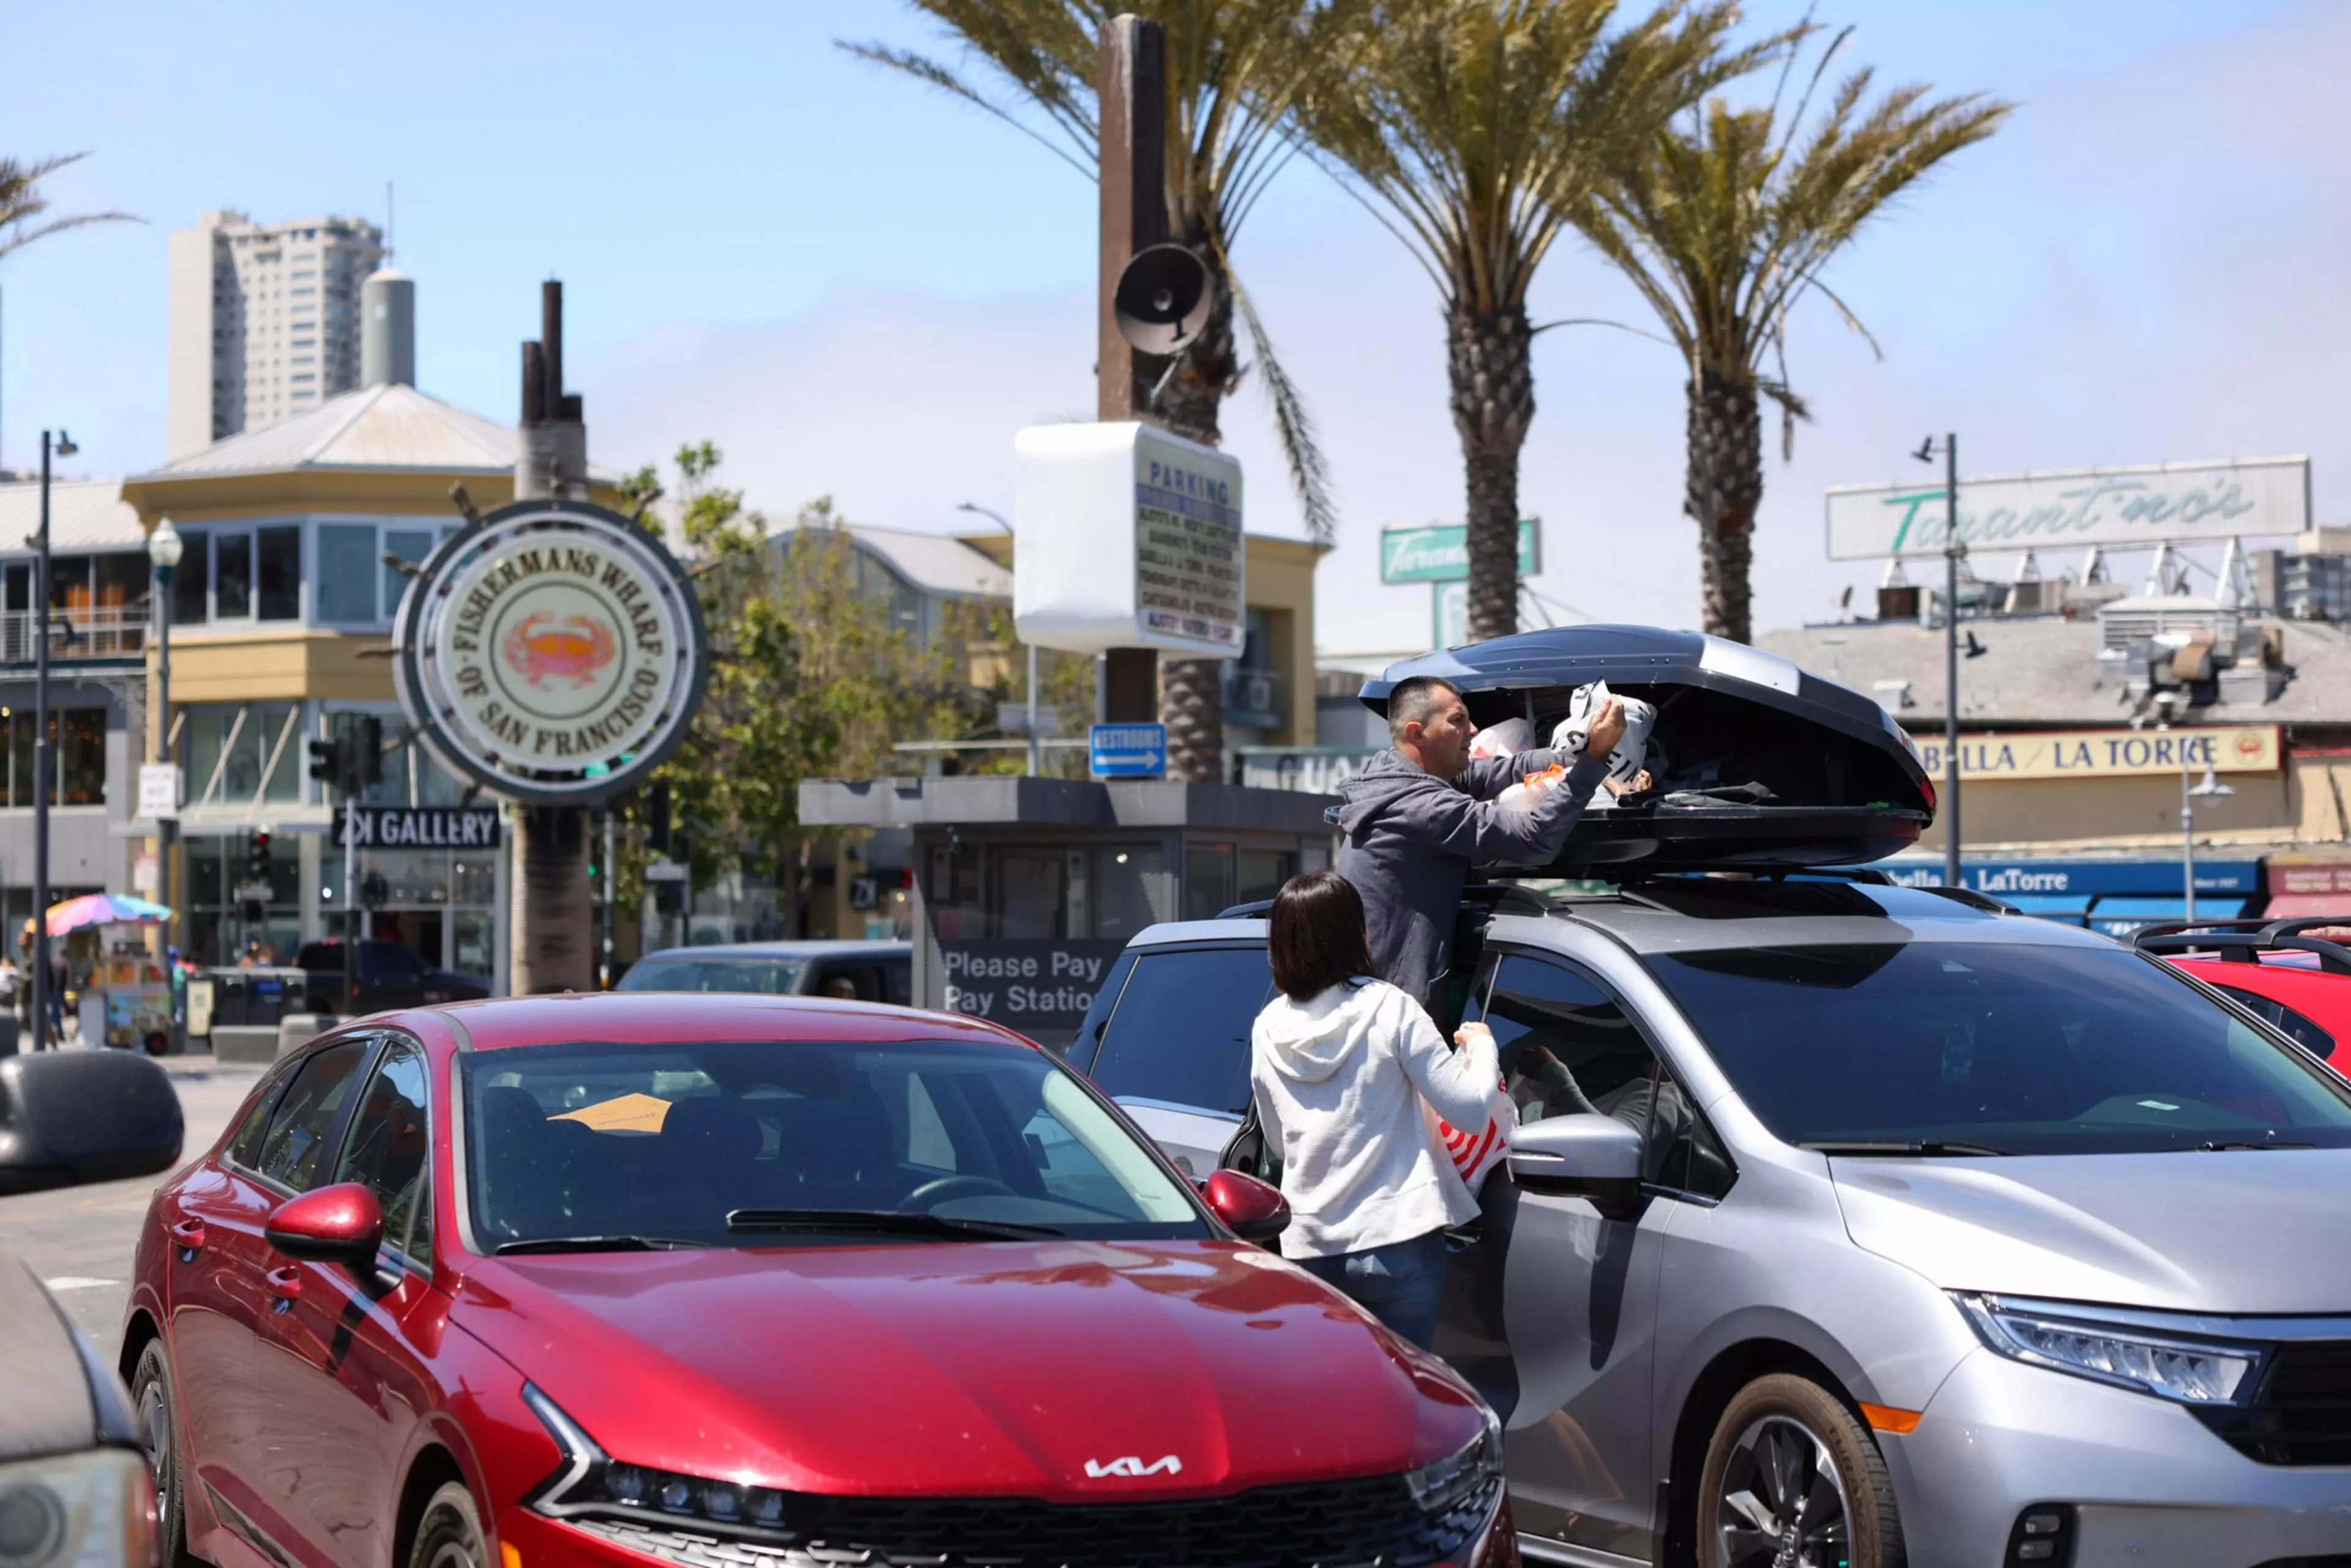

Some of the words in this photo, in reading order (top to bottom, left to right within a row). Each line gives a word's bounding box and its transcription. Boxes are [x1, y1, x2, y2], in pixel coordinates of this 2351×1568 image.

[1150, 461, 1228, 506] PARKING
[1881, 476, 2254, 552] Tarantno's
[599, 561, 662, 657] WHARF
[456, 666, 489, 697] OF
[478, 702, 529, 747] SAN
[534, 669, 659, 756] FRANCISCO
[1923, 744, 2015, 772] BLLA
[2054, 741, 2093, 770] LA
[380, 811, 495, 845] GALLERY
[1978, 868, 2069, 890] LaTorre
[945, 951, 1038, 978] Please
[1052, 951, 1102, 982] Pay
[945, 985, 994, 1017] Pay
[1007, 985, 1095, 1011] Statio
[1084, 1455, 1182, 1477] KIA
